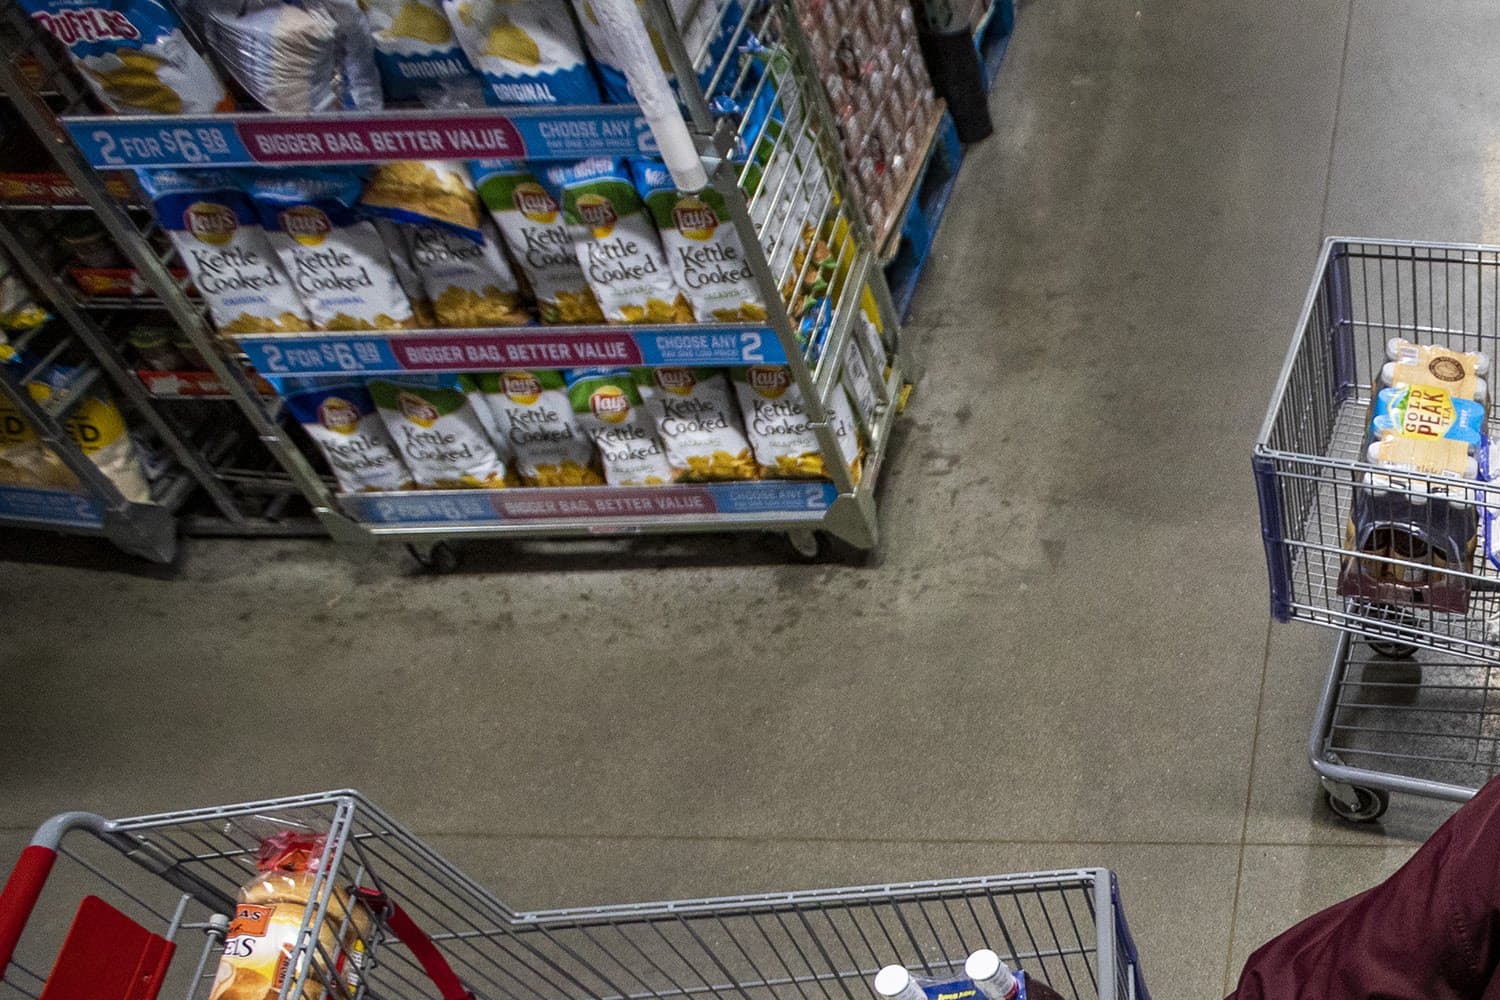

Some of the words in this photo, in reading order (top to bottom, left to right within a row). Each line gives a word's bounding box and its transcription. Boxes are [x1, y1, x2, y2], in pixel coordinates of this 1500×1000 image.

[491, 83, 556, 103] ORIGINAL
[255, 133, 325, 156] BIGGER
[370, 129, 443, 153] BETTER
[446, 127, 510, 150] VALUE
[539, 121, 598, 138] CHOOSE
[602, 120, 632, 136] ANY
[92, 130, 126, 165] 2
[119, 136, 164, 158] FOR
[158, 127, 230, 164] $6.98
[521, 226, 573, 250] Kettl
[678, 242, 737, 269] Kettle
[199, 266, 280, 295] Cooked
[296, 267, 373, 295] Cooked
[588, 254, 657, 285] Cooked
[684, 259, 753, 289] Cooked
[262, 345, 289, 372] 2
[287, 349, 325, 367] FOR
[404, 346, 464, 363] BIGGER
[507, 343, 571, 361] BETTER
[573, 341, 629, 358] VALUE
[655, 335, 709, 349] CHOOSE
[710, 335, 737, 348] ANY
[740, 331, 764, 363] 2
[506, 407, 558, 431] Kettle
[1405, 389, 1423, 433] GOLD
[1417, 391, 1445, 437] PEAK
[661, 412, 728, 438] Cooked
[753, 416, 813, 436] Cooke
[606, 438, 661, 463] ooked
[596, 498, 647, 513] BETTER
[653, 495, 705, 509] VALUE
[806, 485, 826, 509] 2
